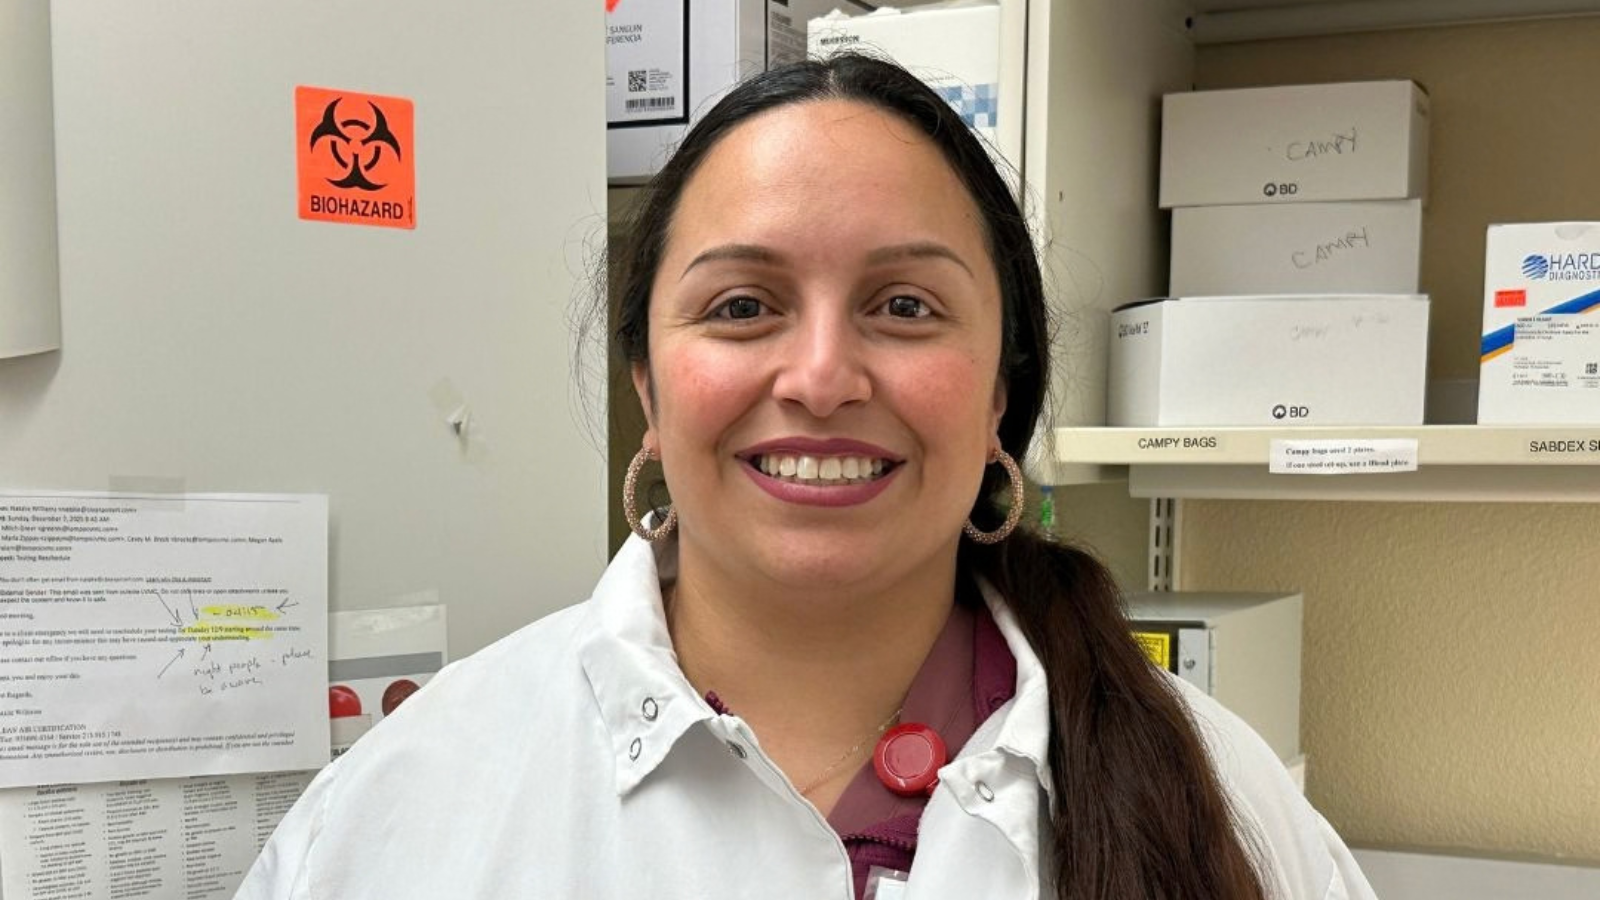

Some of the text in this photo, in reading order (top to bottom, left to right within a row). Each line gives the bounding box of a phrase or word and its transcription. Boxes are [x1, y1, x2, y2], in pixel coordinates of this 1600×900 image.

[1286, 128, 1357, 161] CAMPY
[1280, 184, 1297, 195] BD
[310, 195, 404, 220] BIOHAZARD
[1291, 227, 1369, 269] CAMPY
[1289, 406, 1309, 418] BD
[1138, 437, 1216, 449] CAMPY BAGS
[1530, 440, 1600, 452] SABDEX S
